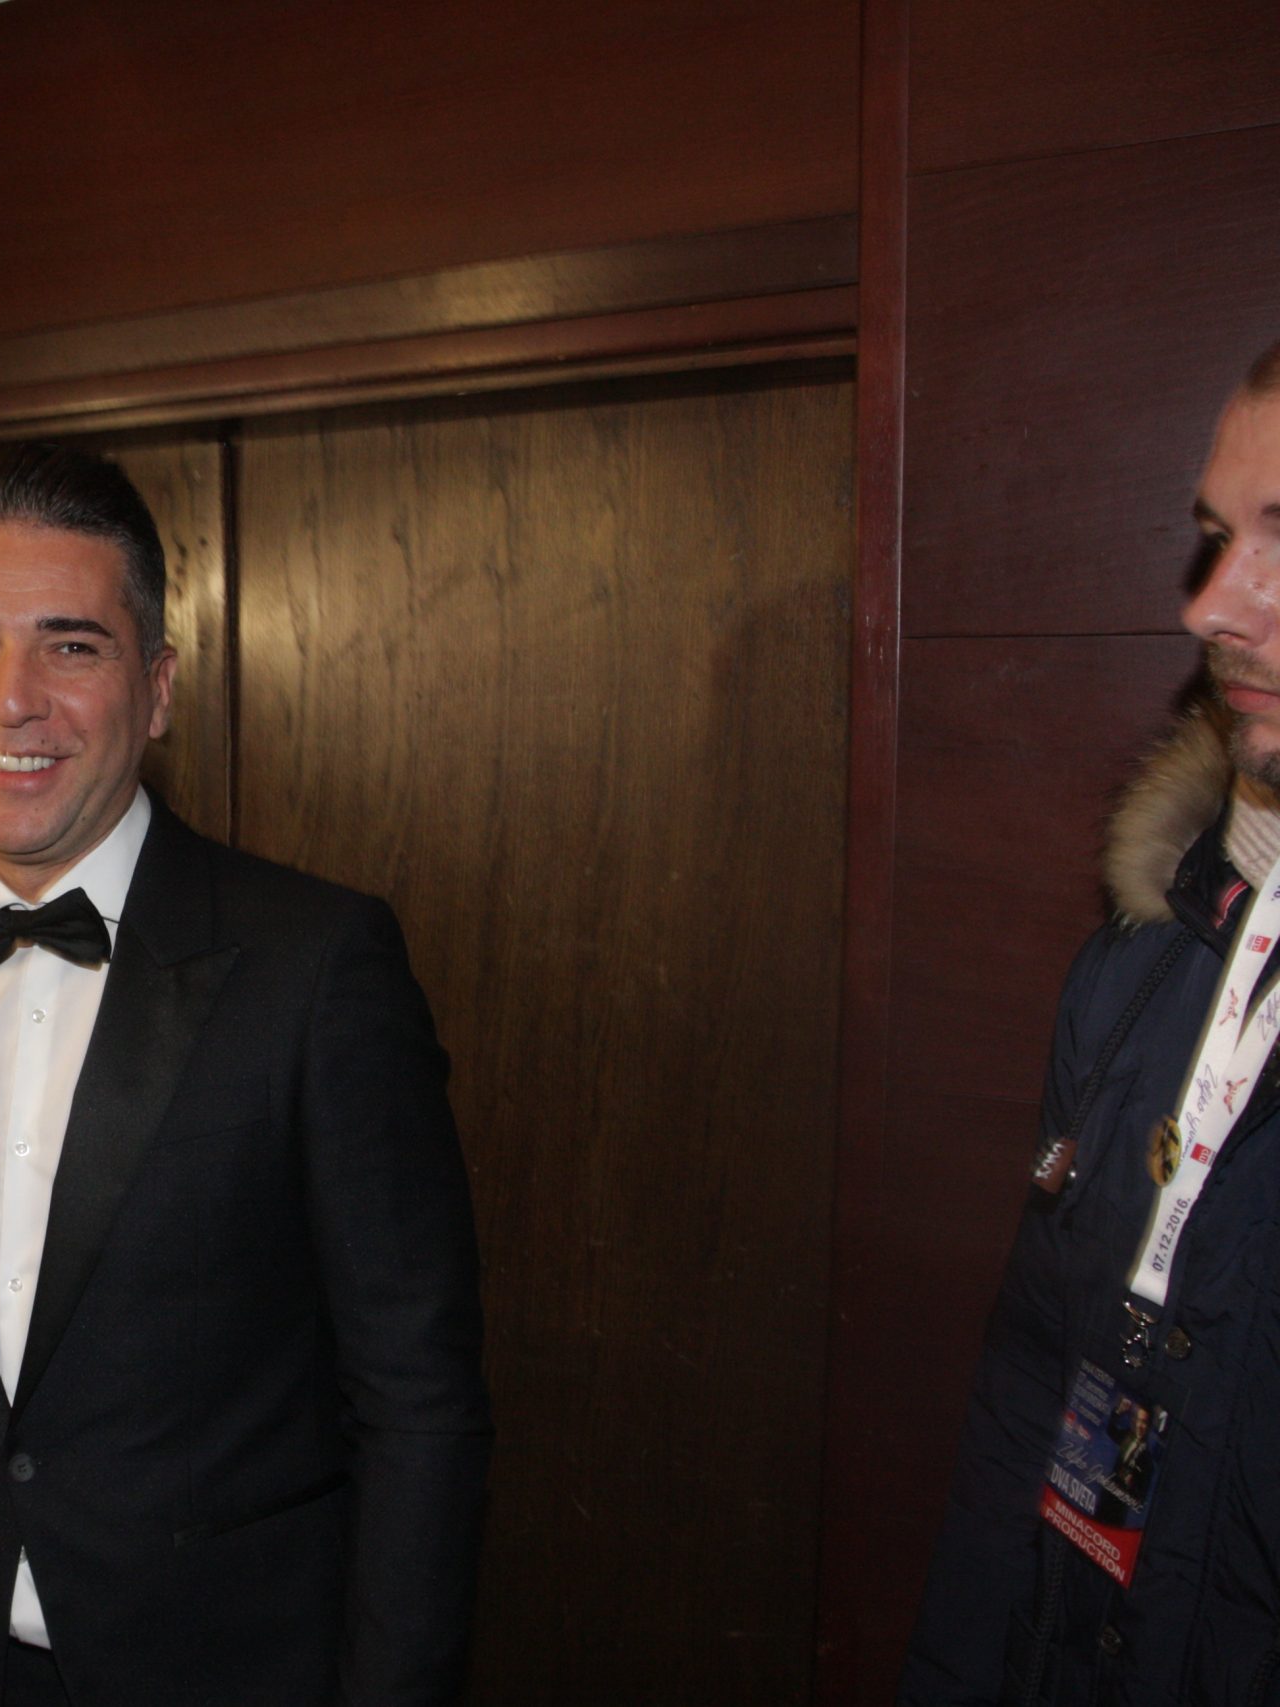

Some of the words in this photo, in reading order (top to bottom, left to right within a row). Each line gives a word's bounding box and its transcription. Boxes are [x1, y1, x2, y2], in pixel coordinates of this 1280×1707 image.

[1151, 1198, 1191, 1272] 07.12.2016.
[1044, 1507, 1125, 1582] PRODUCTION
[1054, 1500, 1122, 1561] MINACORD
